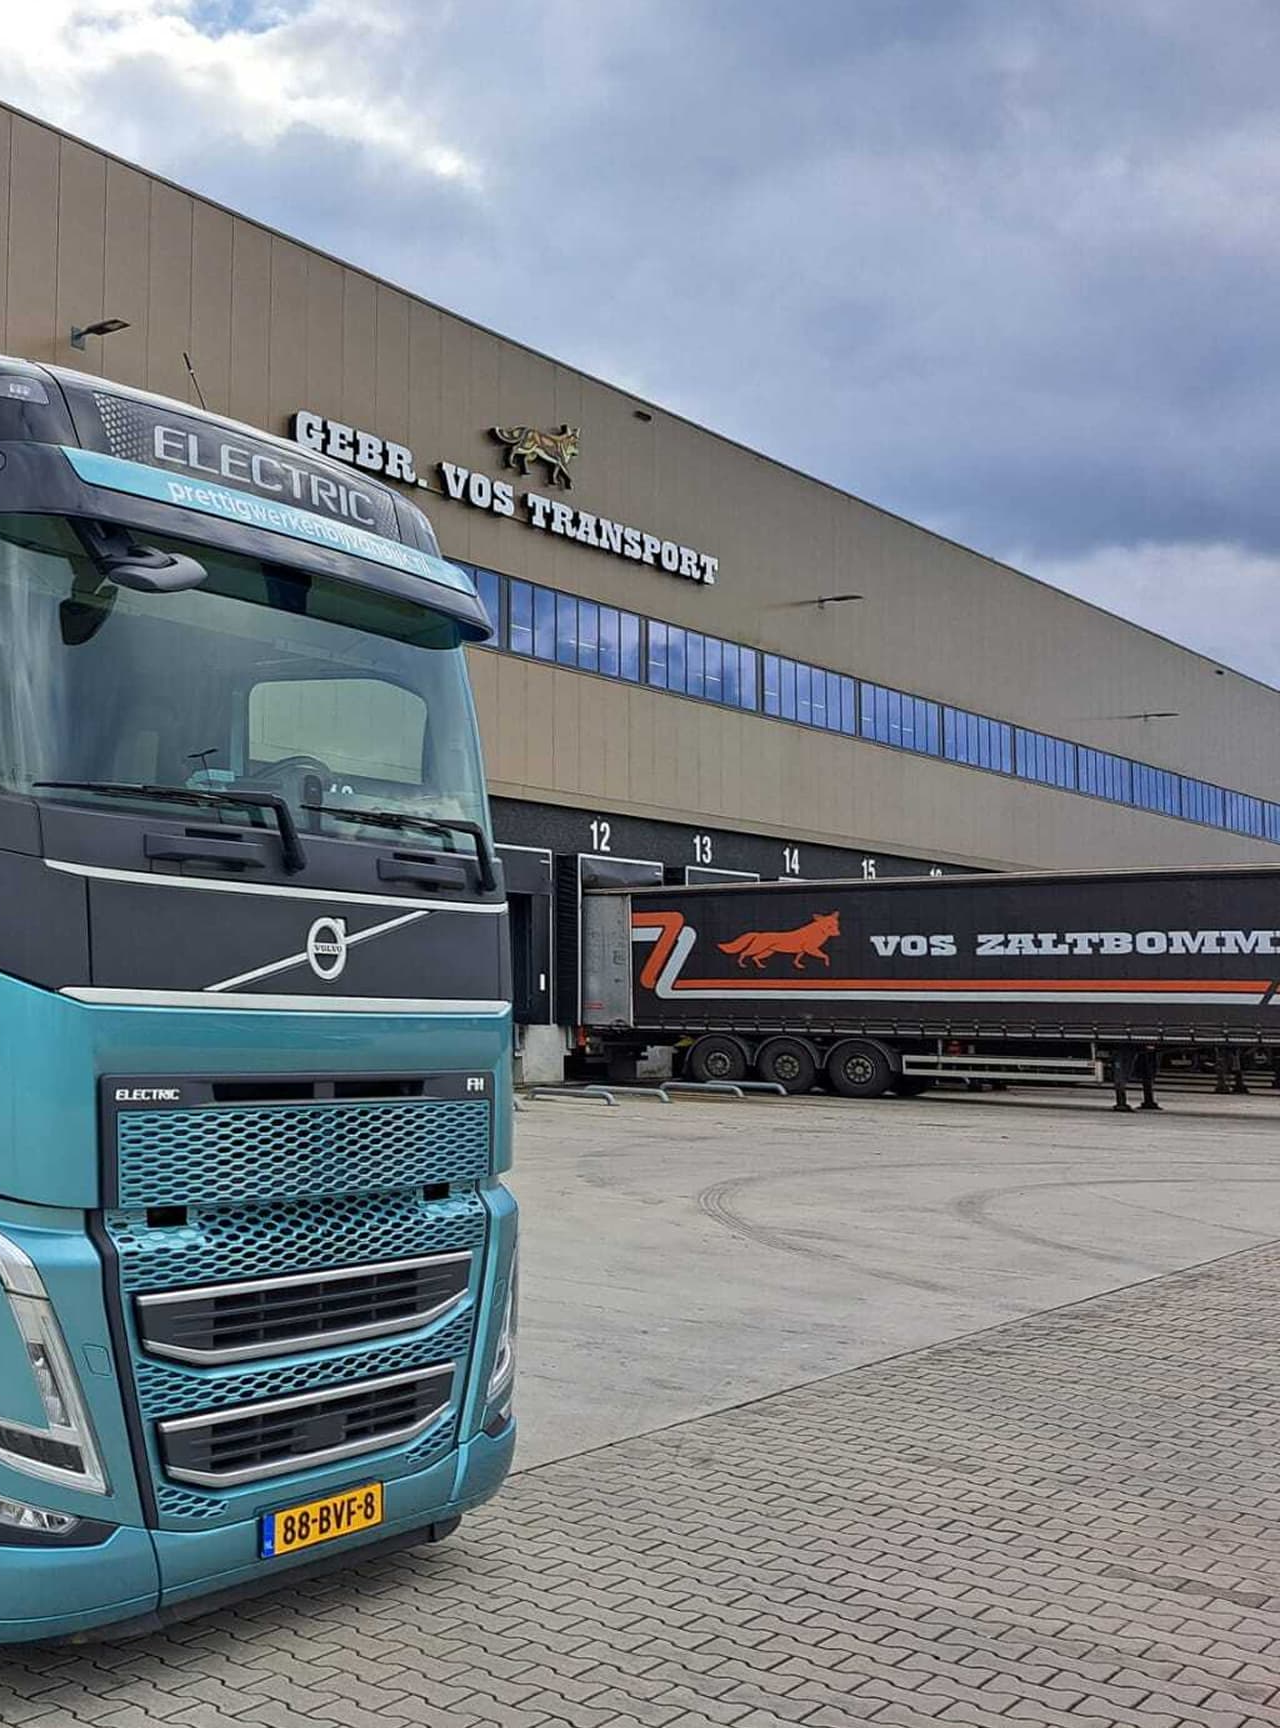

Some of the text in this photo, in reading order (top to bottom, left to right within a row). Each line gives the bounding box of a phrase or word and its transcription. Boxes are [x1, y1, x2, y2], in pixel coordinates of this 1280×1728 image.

[153, 425, 375, 526] ELECTRIC
[295, 410, 719, 585] GEBR. VOS TRANSPORT
[589, 820, 612, 852] 12
[693, 834, 713, 864] 13
[783, 846, 801, 875] 14
[861, 858, 877, 880] 15
[314, 944, 343, 953] VOLVO
[869, 931, 1280, 958] VOS ZALTBOMM
[115, 1088, 181, 1101] ELECTRIC
[282, 1491, 376, 1545] 88-BVF-8
